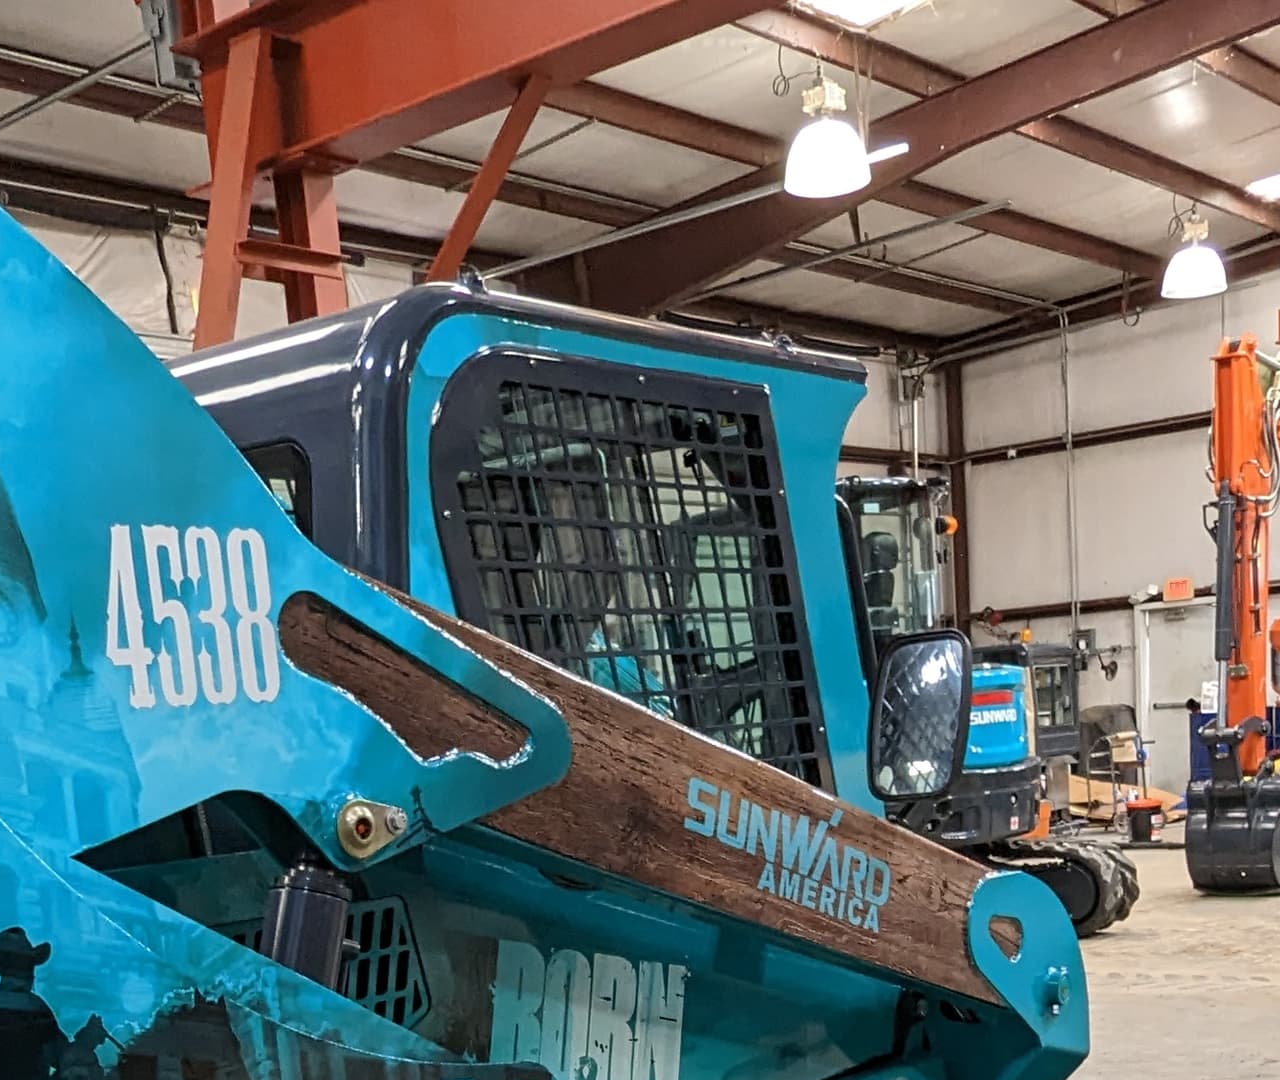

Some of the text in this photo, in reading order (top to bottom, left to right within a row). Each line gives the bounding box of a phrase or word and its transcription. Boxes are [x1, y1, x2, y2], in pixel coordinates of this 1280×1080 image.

[106, 523, 280, 709] 4538
[683, 776, 892, 907] SUNWARD
[757, 862, 880, 934] AMERICA
